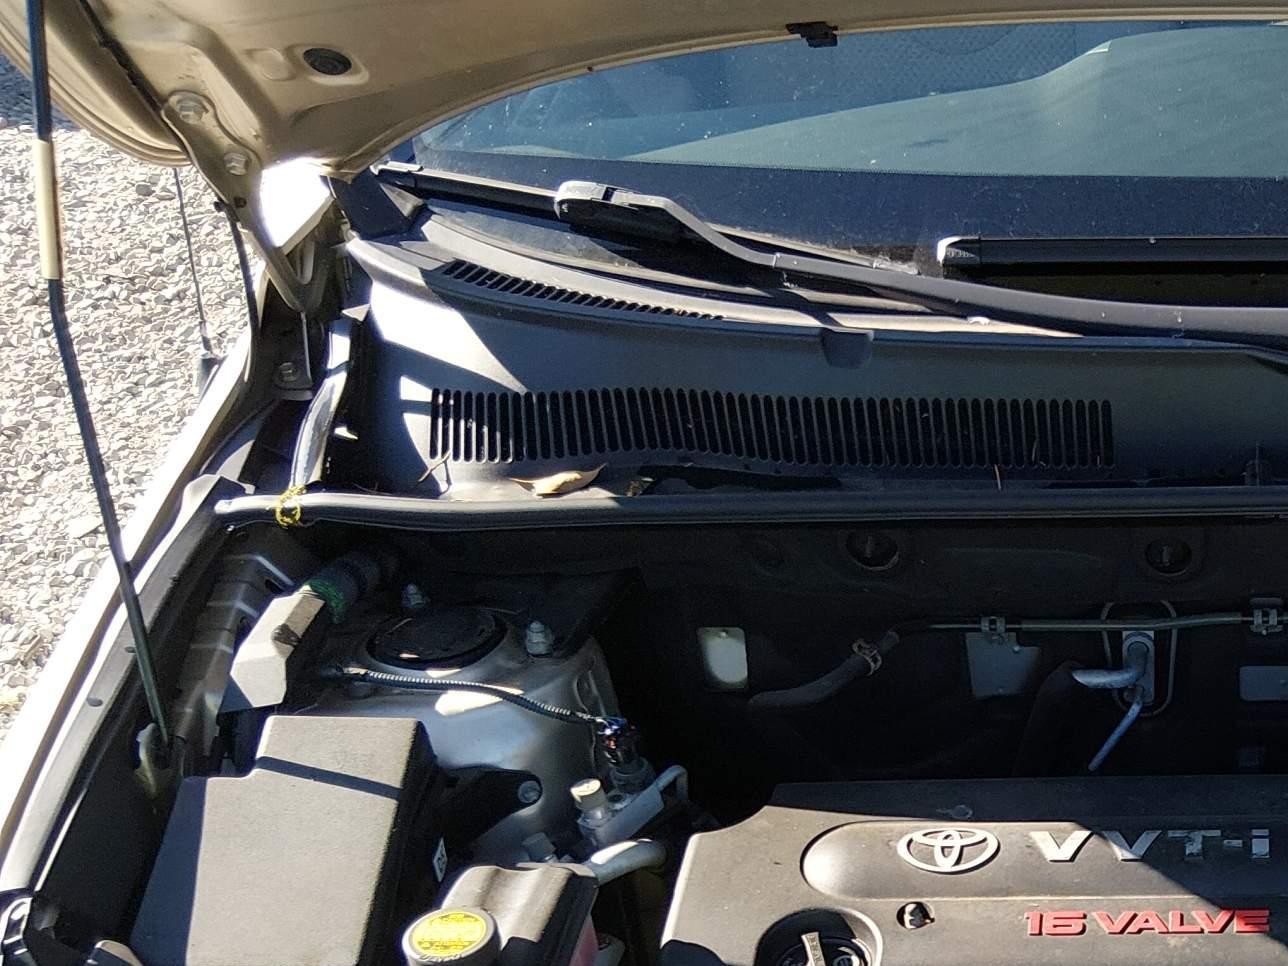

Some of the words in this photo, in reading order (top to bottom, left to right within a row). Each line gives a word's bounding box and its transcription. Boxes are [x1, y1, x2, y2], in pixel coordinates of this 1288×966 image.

[1028, 828, 1270, 862] VVT-i
[1025, 910, 1087, 937] 16
[1093, 908, 1271, 936] VALVE
